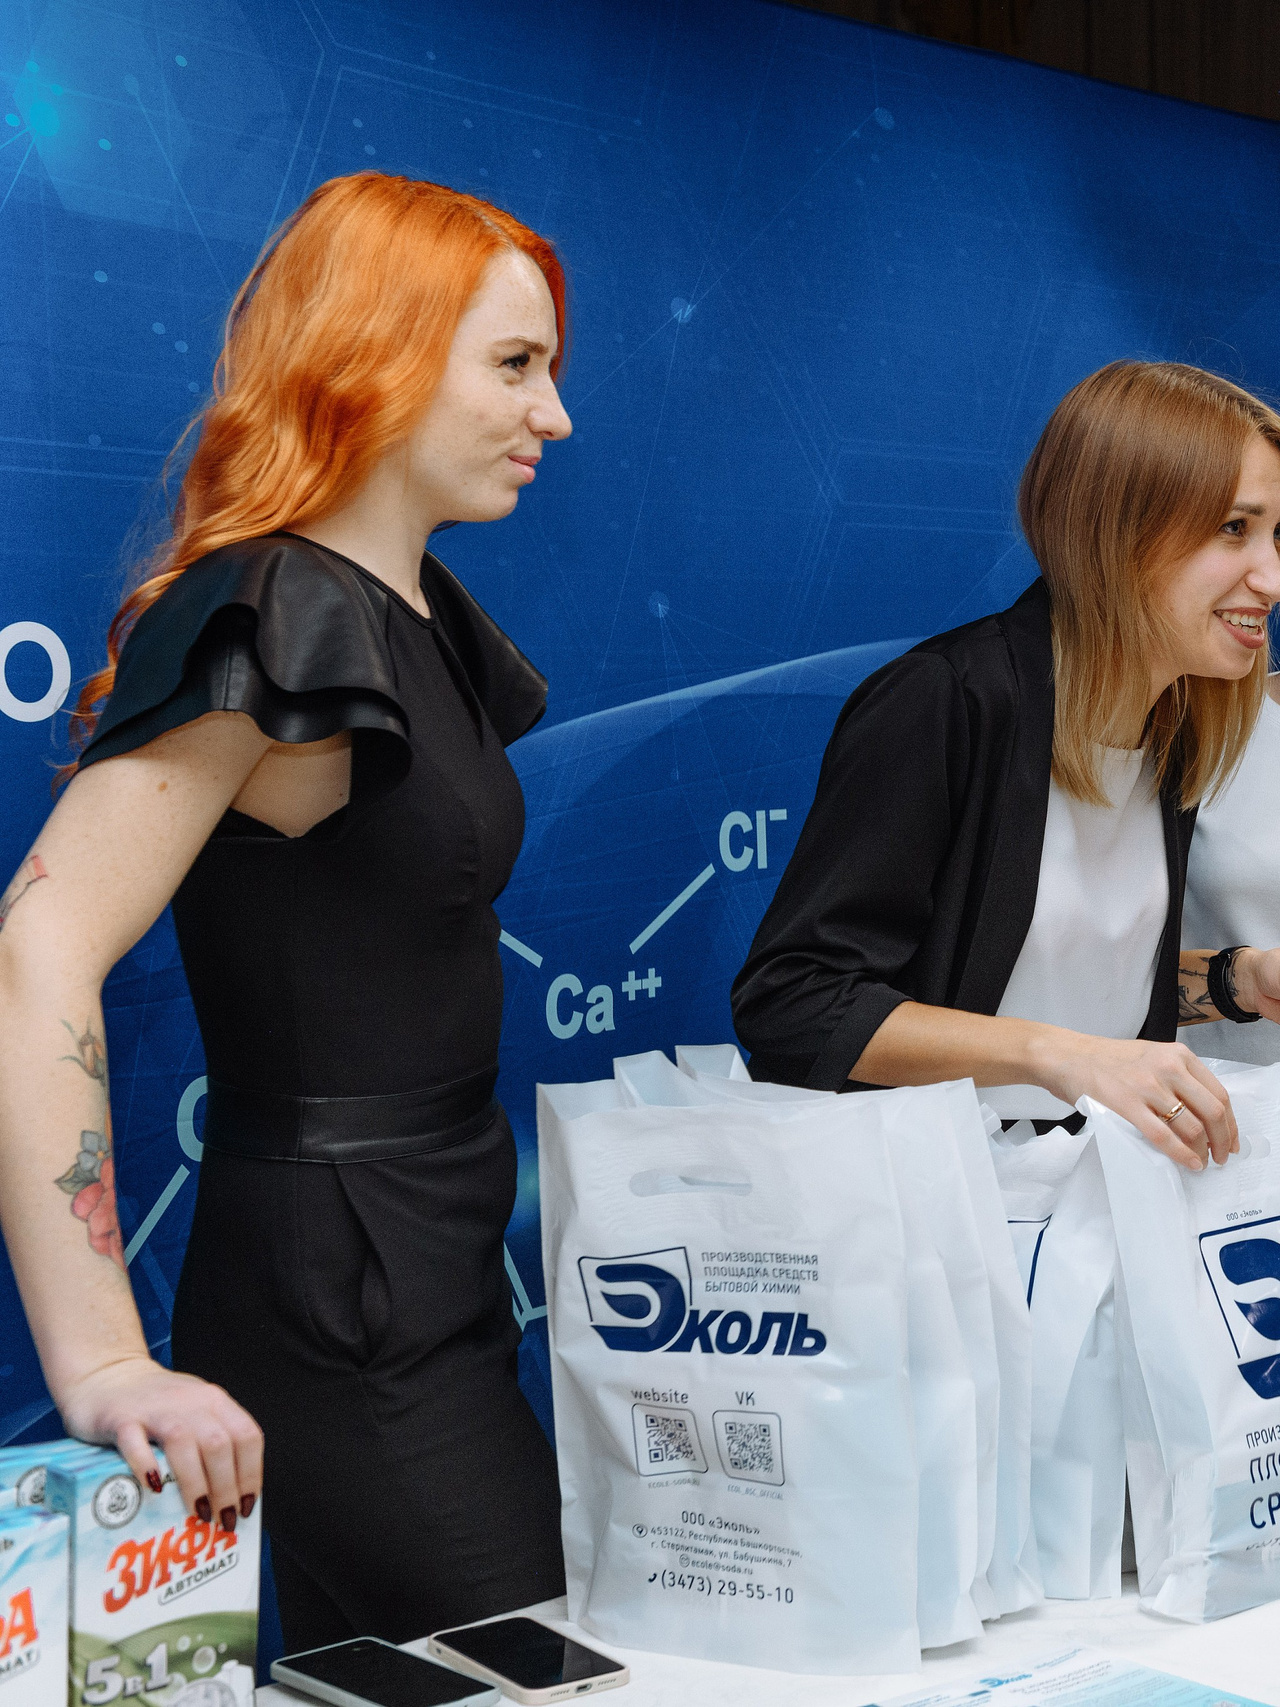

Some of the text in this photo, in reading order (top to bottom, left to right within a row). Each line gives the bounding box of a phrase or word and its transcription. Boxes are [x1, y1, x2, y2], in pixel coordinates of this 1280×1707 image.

[701, 1252, 819, 1265] ПРОИЗВОДСТВЕННАЯ
[704, 1266, 819, 1281] ПЛОЩАДКА СРЕДСТВ
[705, 1280, 801, 1295] БЫТОВОЙ ХИМИИ
[631, 1388, 689, 1404] website
[735, 1391, 755, 1406] VK
[681, 1510, 760, 1535] ООО «Эколь»
[650, 1526, 803, 1558] 453122, Республика Башкортостан,
[661, 1540, 716, 1558] Стерлитамак,
[691, 1559, 753, 1575] ecole@soda.ru
[163, 1552, 235, 1599] АВТОМАТ
[661, 1569, 794, 1604] (3473) 29-55-10
